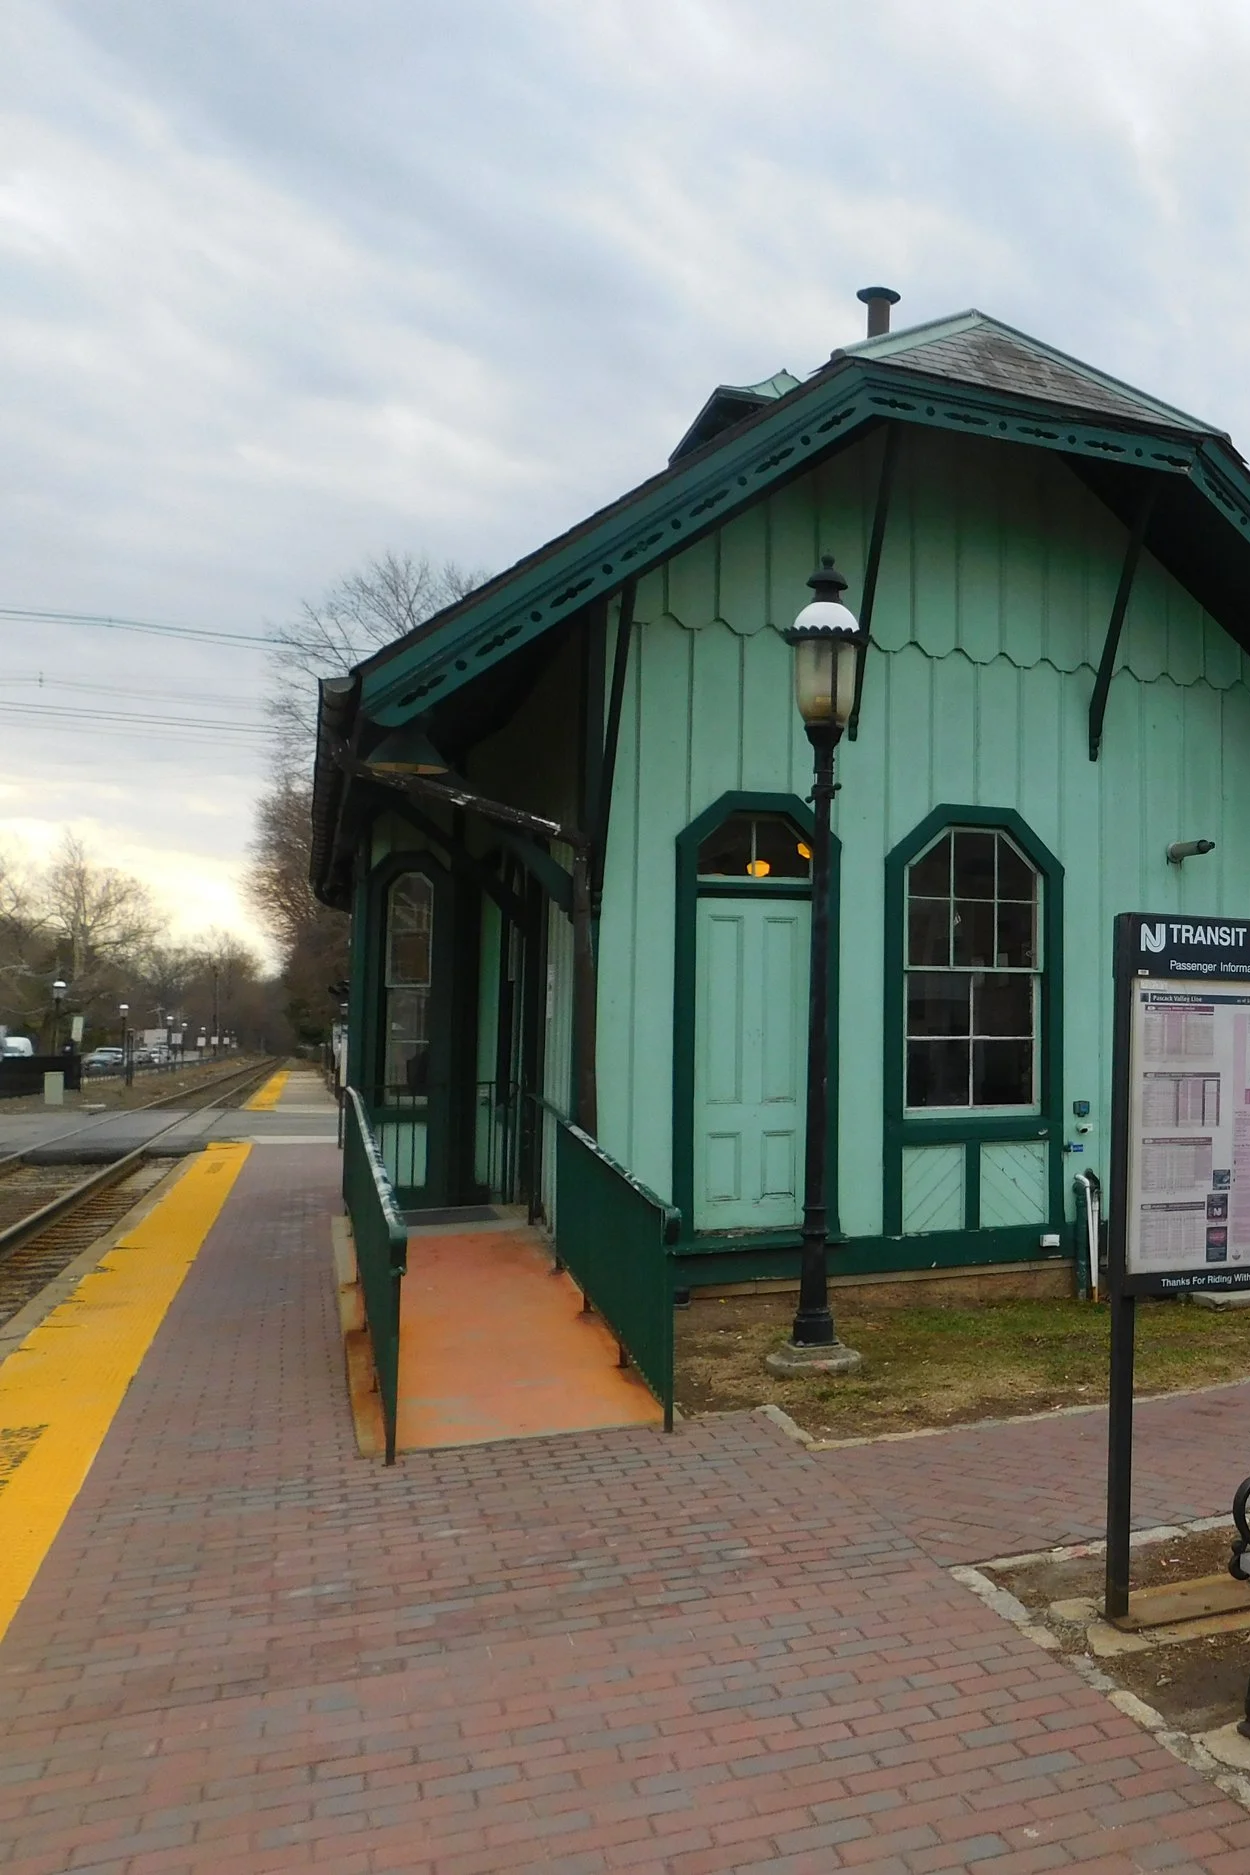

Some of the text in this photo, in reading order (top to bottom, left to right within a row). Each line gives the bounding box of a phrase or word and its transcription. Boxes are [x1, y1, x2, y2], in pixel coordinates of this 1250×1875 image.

[1140, 923, 1247, 953] NJ TRANSIT
[1170, 960, 1217, 973] Passenger
[1161, 1277, 1191, 1287] Thanks
[1192, 1276, 1206, 1285] For
[1207, 1275, 1232, 1284] Riding
